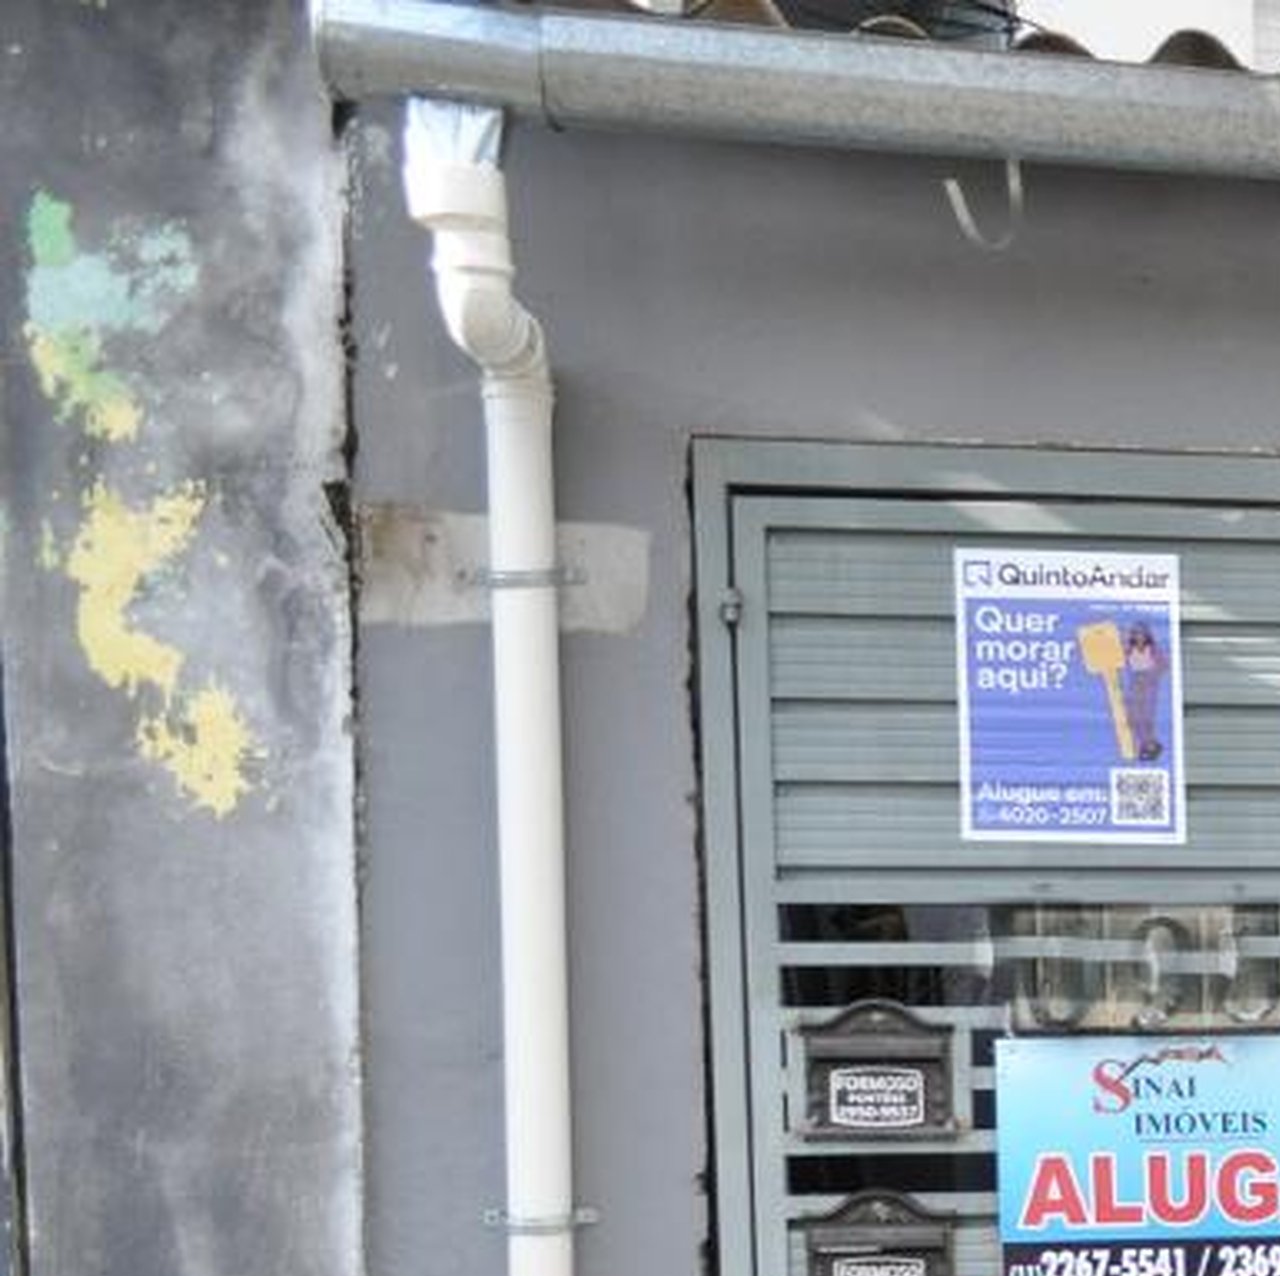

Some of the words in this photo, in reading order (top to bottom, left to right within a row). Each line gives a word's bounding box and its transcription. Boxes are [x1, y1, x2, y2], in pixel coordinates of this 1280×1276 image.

[998, 562, 1170, 589] QuintoAndar
[976, 606, 1060, 633] Quer
[977, 641, 1075, 661] morar
[978, 662, 1068, 694] aqui?
[978, 780, 1060, 804] Alugue
[837, 1075, 918, 1091] FORMOSO
[1092, 1057, 1196, 1114] SINAI
[1134, 1106, 1268, 1135] IMÓVEIS
